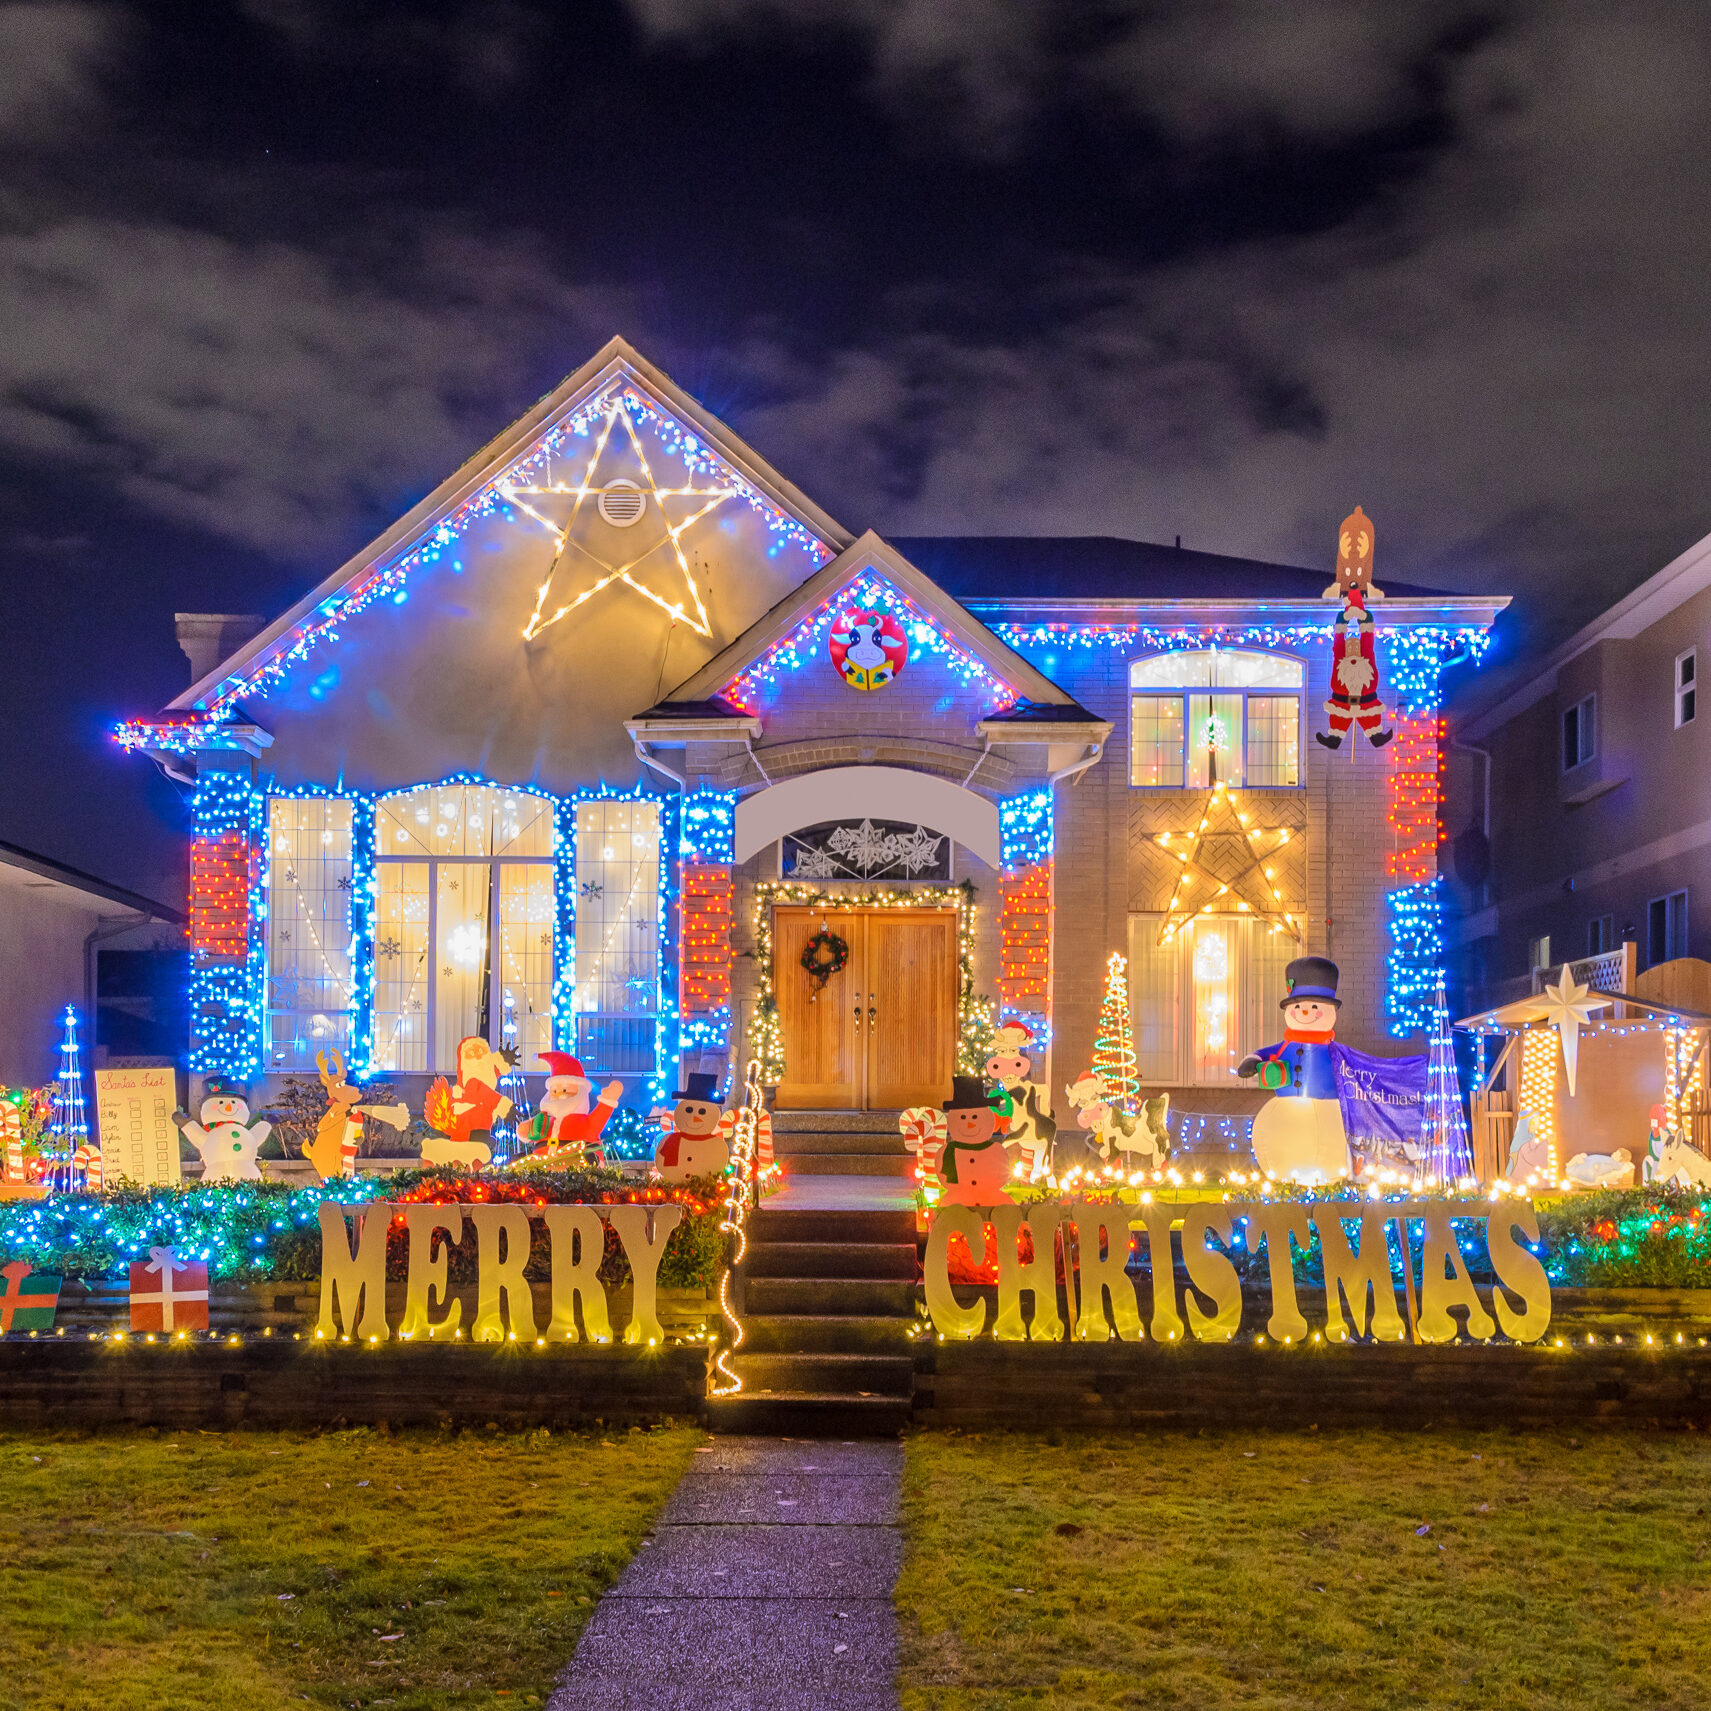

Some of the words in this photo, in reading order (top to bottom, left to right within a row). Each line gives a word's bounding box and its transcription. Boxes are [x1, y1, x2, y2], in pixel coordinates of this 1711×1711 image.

[140, 1072, 166, 1087] List
[1344, 1081, 1420, 1106] Christmas!
[314, 1201, 682, 1343] MERRY
[926, 1202, 1552, 1344] CHRISTMAS
